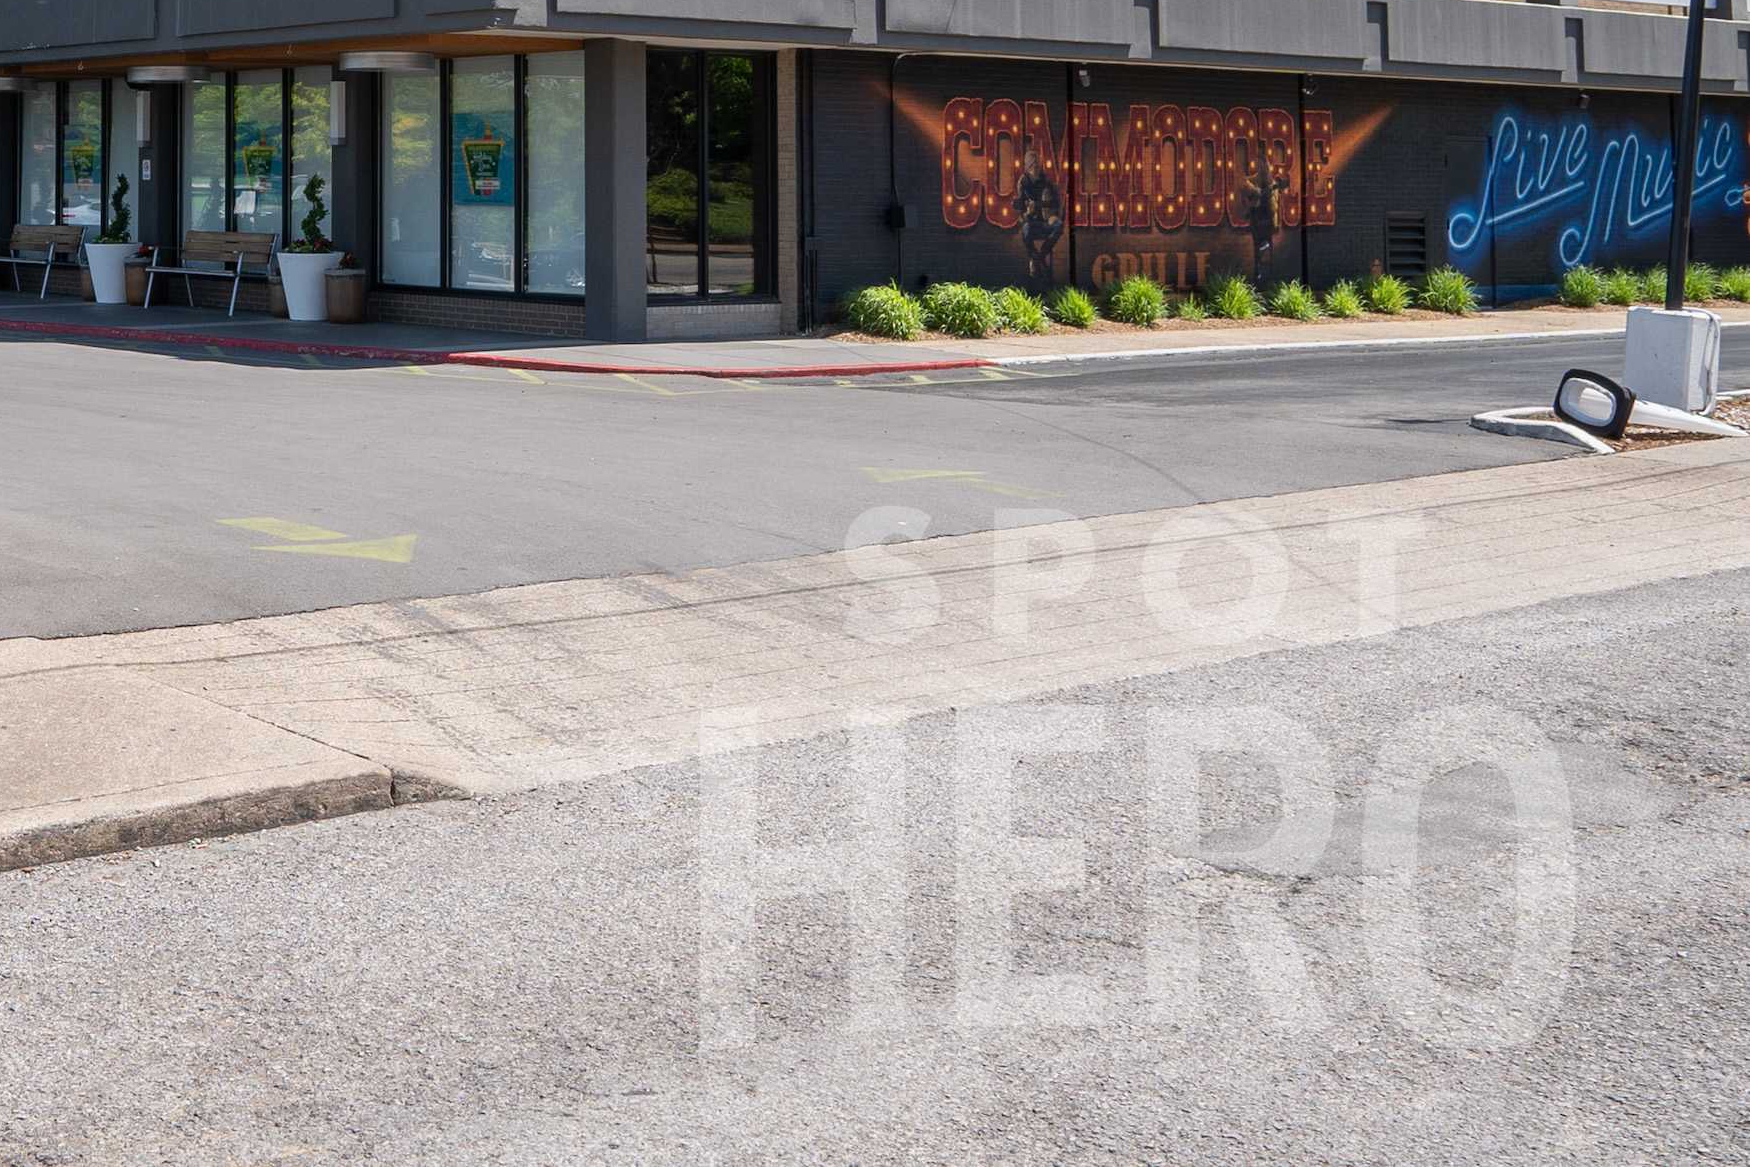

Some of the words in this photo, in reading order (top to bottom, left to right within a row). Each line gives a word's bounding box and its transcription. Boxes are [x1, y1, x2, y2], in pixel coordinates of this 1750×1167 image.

[942, 97, 1336, 230] COMMODORE
[1449, 117, 1588, 248] Live
[1560, 119, 1732, 266] Muic
